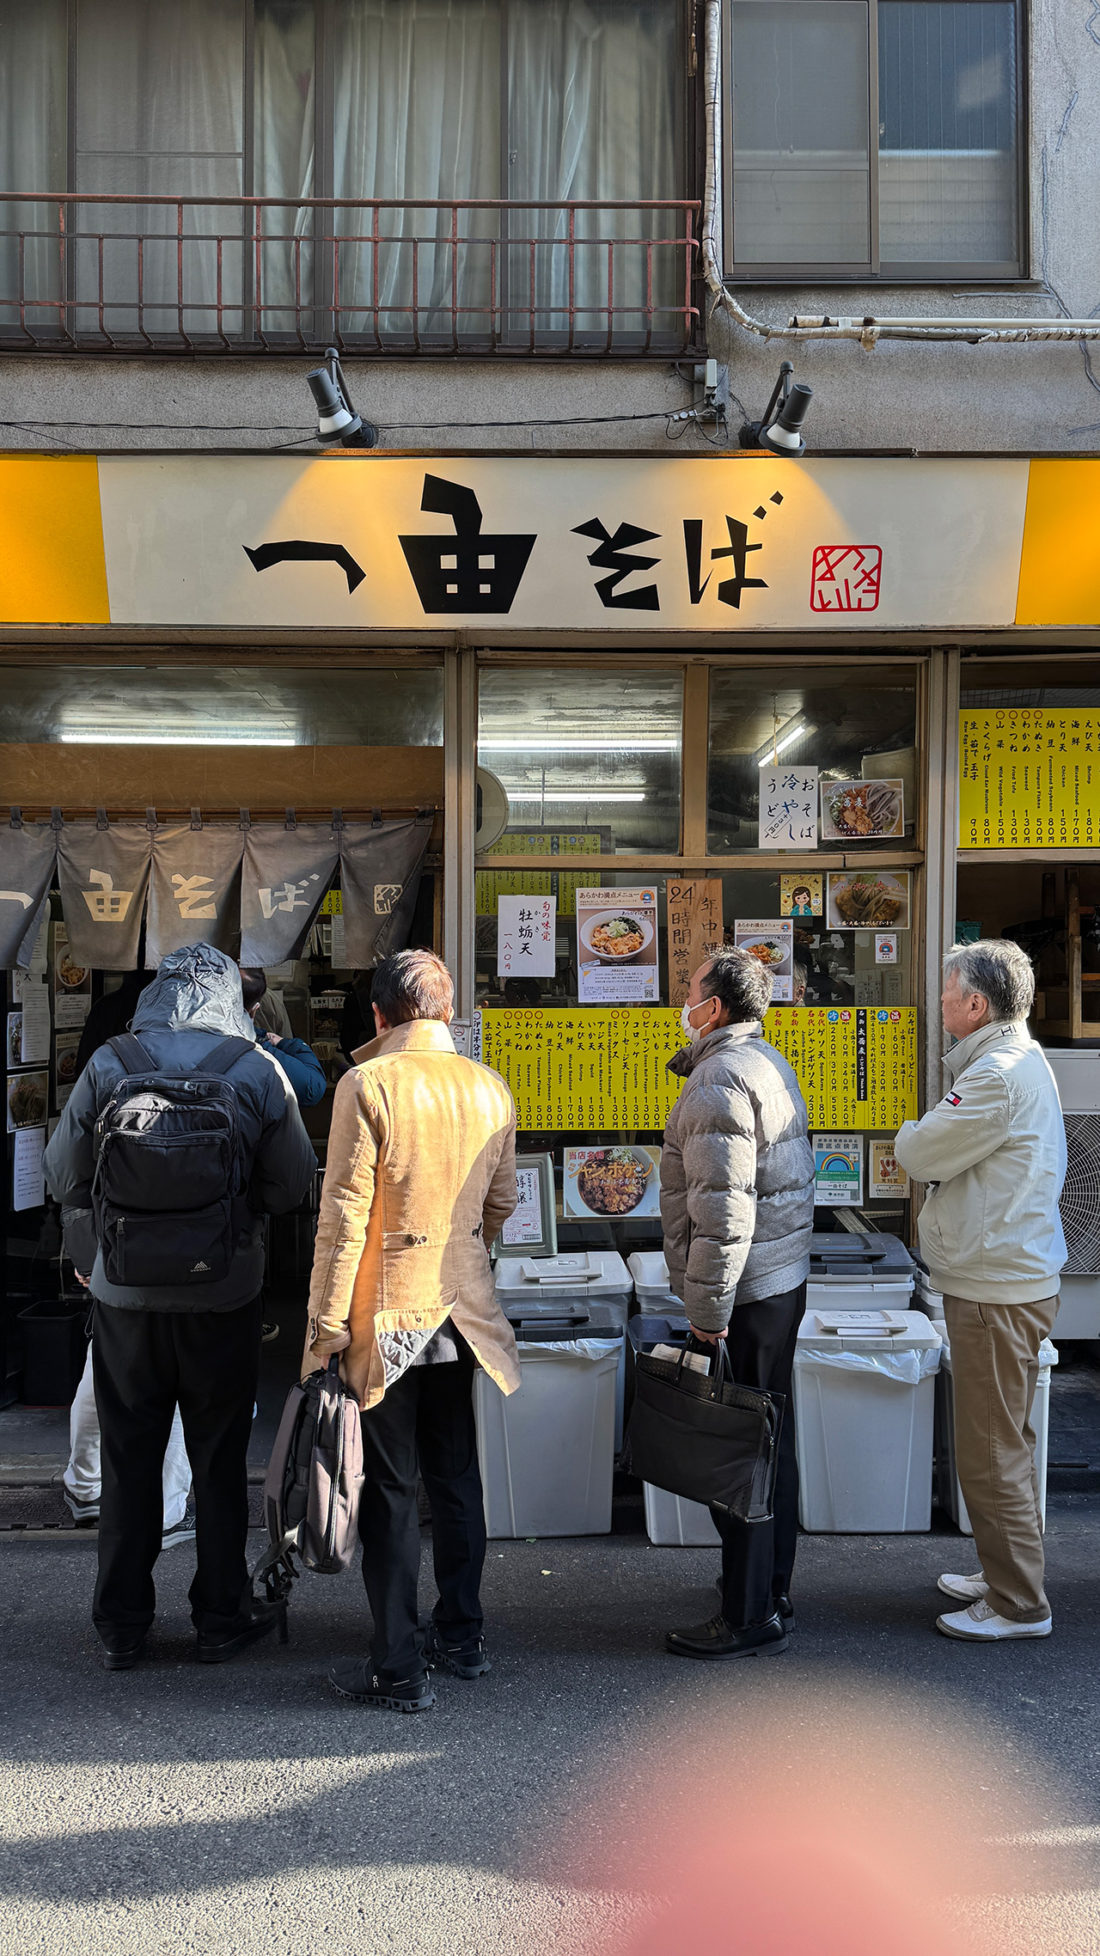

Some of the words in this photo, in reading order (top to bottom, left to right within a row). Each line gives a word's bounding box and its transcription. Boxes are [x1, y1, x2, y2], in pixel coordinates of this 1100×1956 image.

[781, 773, 799, 841] 冷やし
[801, 779, 815, 838] おそば
[519, 909, 533, 956] 牡蛎天
[541, 901, 551, 941] 旬の味覚
